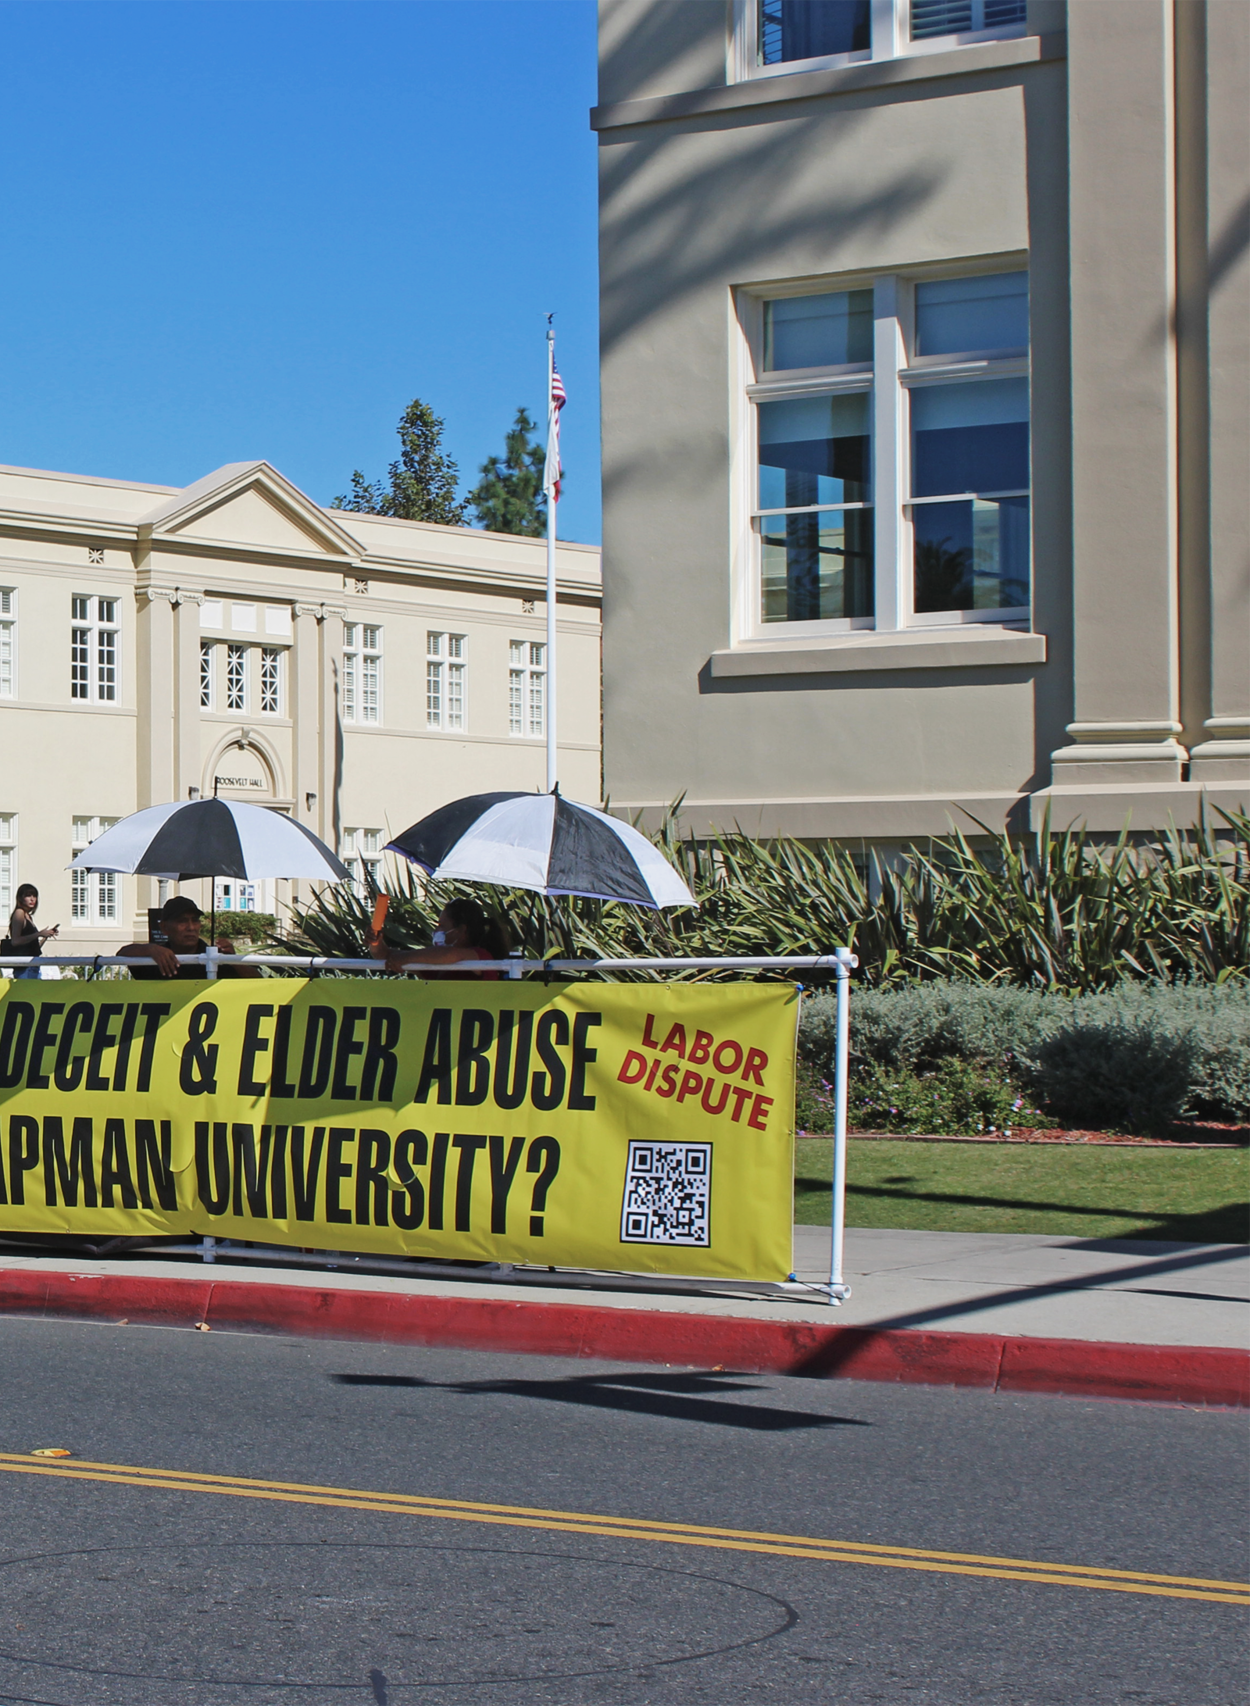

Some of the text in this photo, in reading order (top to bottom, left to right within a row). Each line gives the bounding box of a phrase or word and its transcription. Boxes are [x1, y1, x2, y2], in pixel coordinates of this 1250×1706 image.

[216, 776, 263, 788] ROOSEVELT HALL
[179, 1001, 219, 1096] &
[238, 1004, 401, 1103] ELDER
[414, 1007, 602, 1111] ABUSE
[617, 1049, 774, 1131] DISPUTE
[640, 1013, 768, 1087] LABOR
[194, 1121, 561, 1237] UNIVERSITY?
